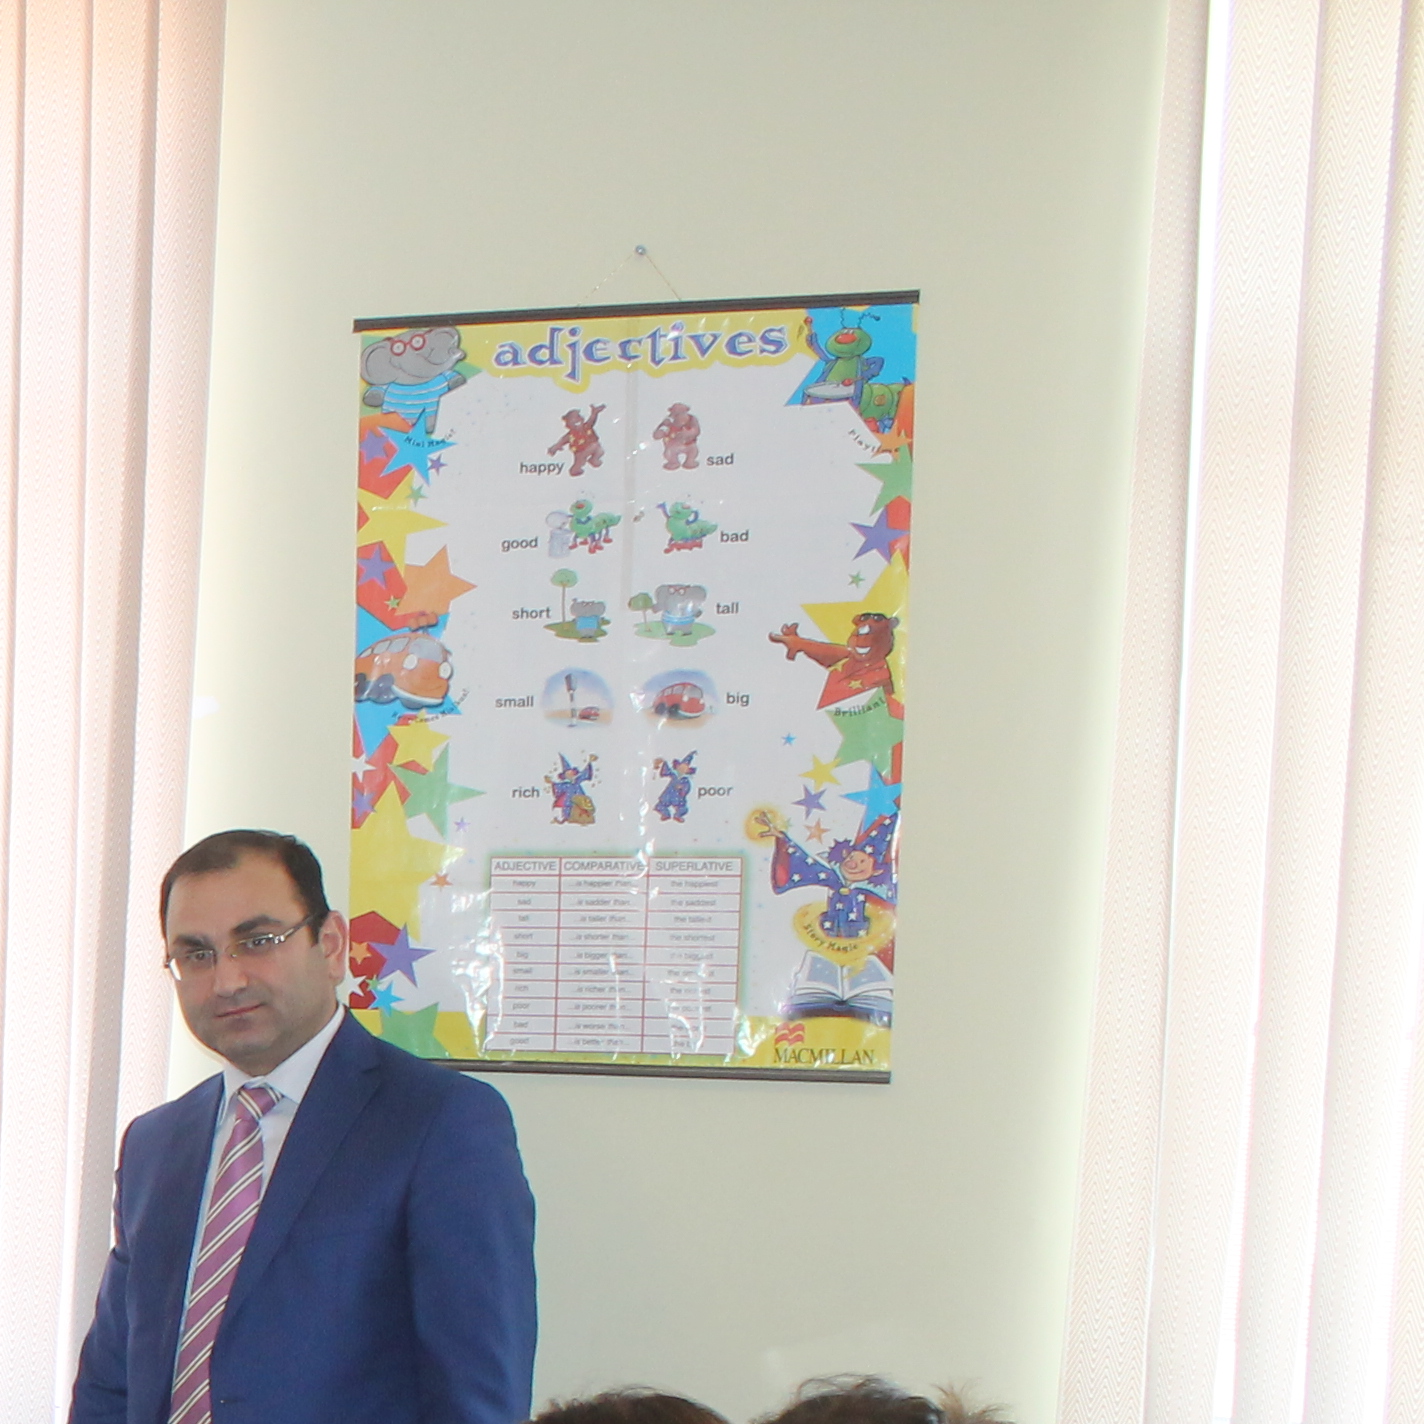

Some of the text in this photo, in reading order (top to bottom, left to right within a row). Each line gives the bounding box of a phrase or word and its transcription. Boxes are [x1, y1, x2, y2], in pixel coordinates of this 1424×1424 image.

[493, 321, 789, 383] adjectives
[706, 454, 734, 467] sad
[519, 461, 564, 477] happy
[720, 530, 749, 543] bad
[502, 537, 538, 551] good
[512, 607, 551, 619] short
[716, 603, 739, 615] tall
[495, 696, 534, 708] small
[726, 692, 750, 706] big
[512, 787, 540, 798] rich
[698, 787, 733, 800] poor
[494, 861, 733, 872] ADJECTIVE COMPARATIVE SUPERLATIVE
[803, 923, 826, 947] Story
[773, 1048, 874, 1065] MACMILLAN
